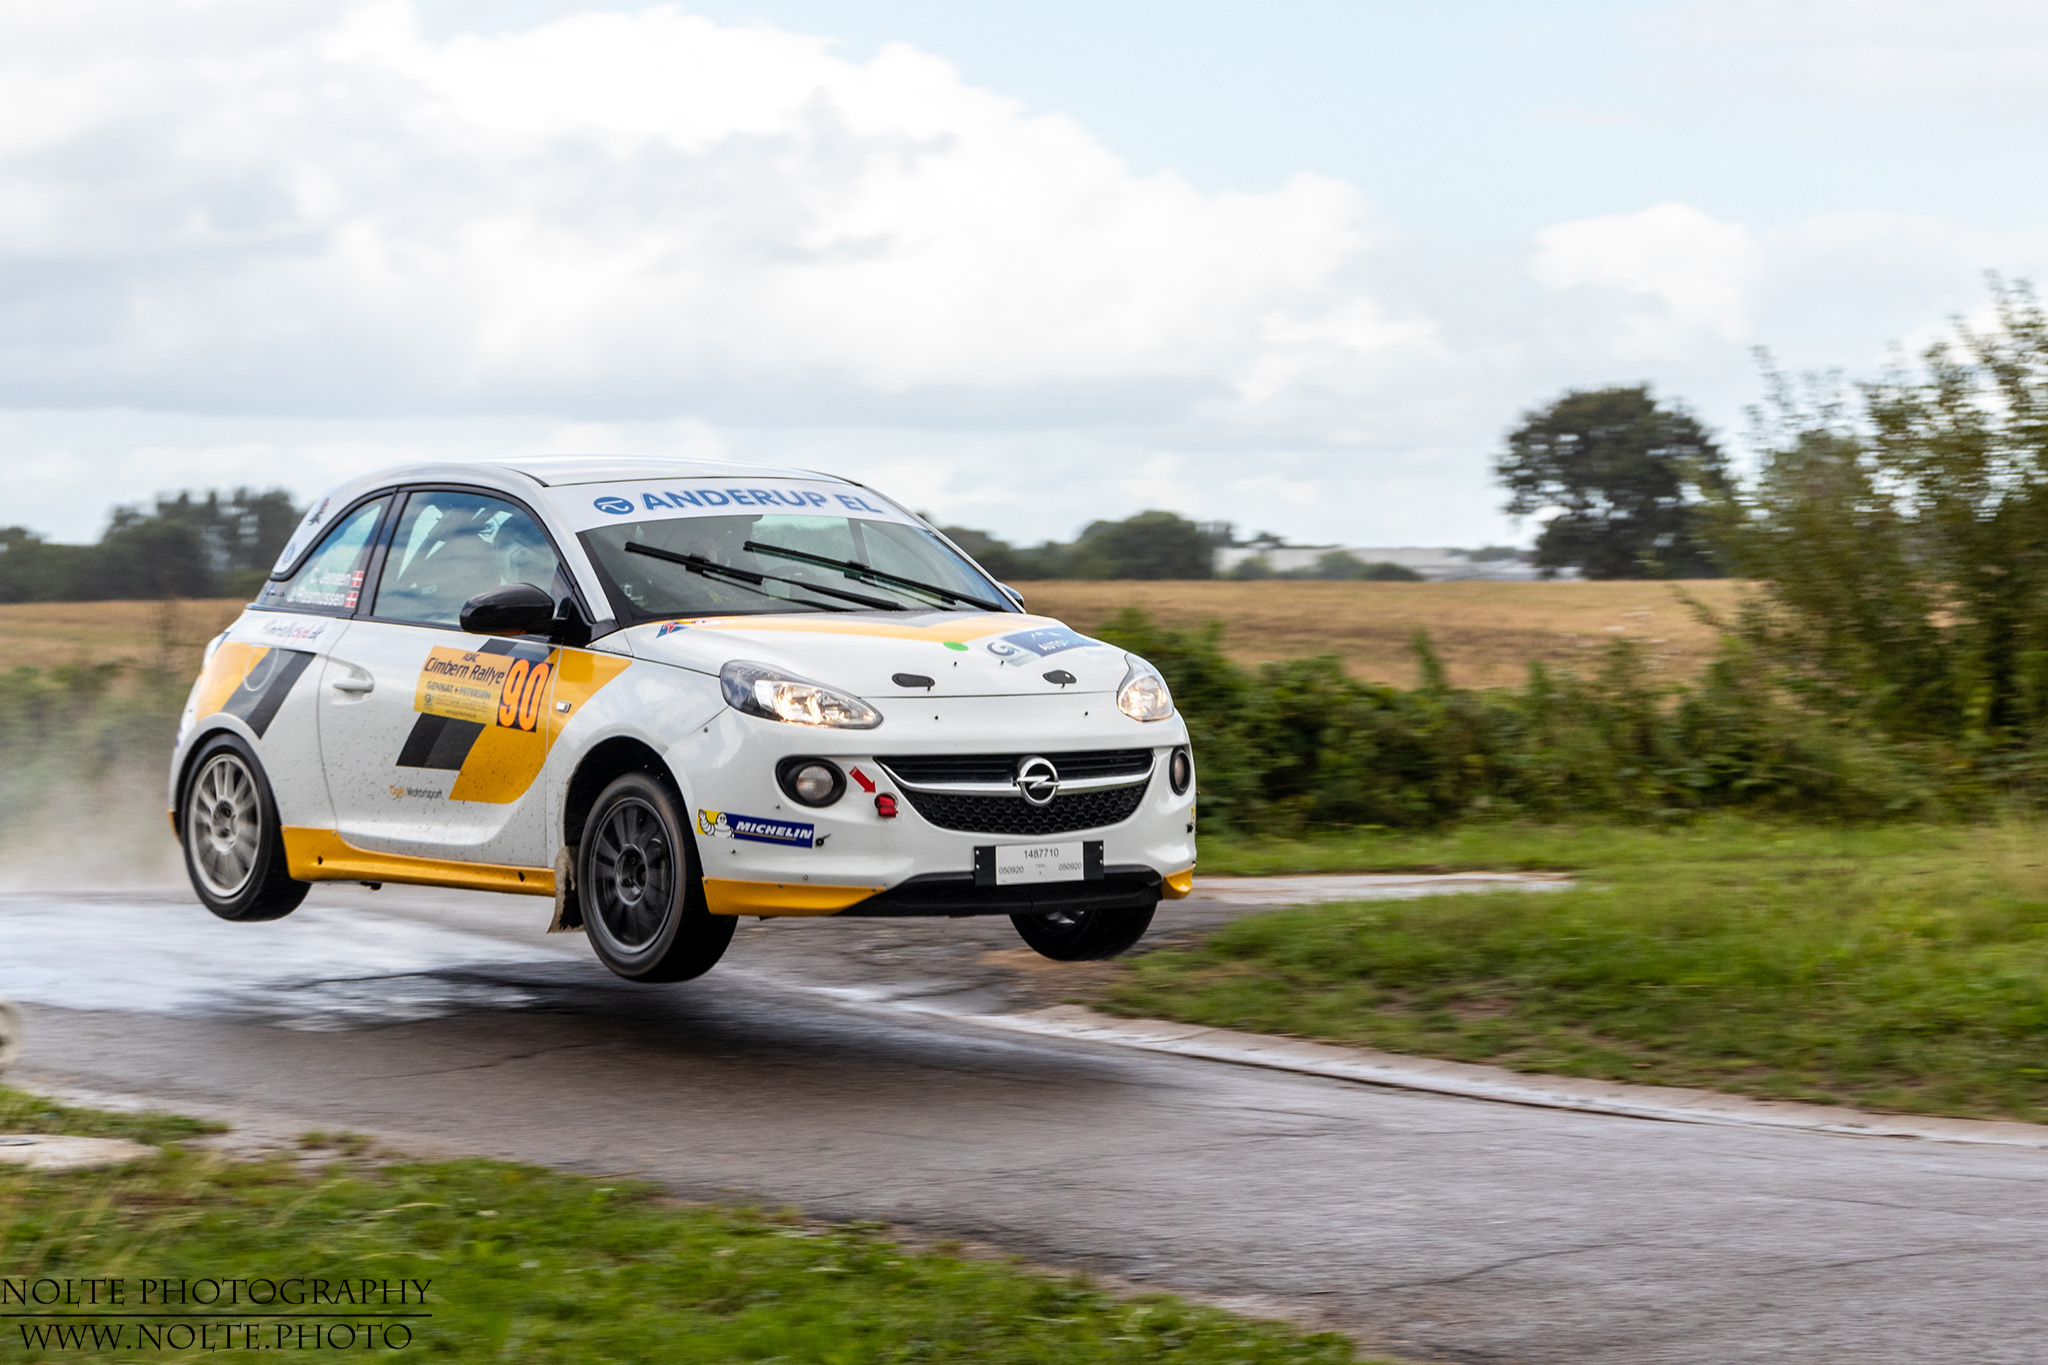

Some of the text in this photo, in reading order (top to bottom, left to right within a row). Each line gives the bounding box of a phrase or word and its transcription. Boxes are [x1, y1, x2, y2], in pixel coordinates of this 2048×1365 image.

[641, 489, 884, 514] ANDERUP EL
[461, 652, 480, 663] ADAC
[424, 657, 506, 686] Cimbern Rallye
[426, 680, 454, 694] GENNAT
[459, 686, 491, 700] PETERSEN
[499, 658, 550, 731] 90
[406, 786, 444, 800] Motorsport
[735, 820, 812, 839] MICHELIN
[1024, 848, 1059, 859] 1487710
[999, 865, 1024, 875] 050920
[1059, 862, 1082, 872] 050920
